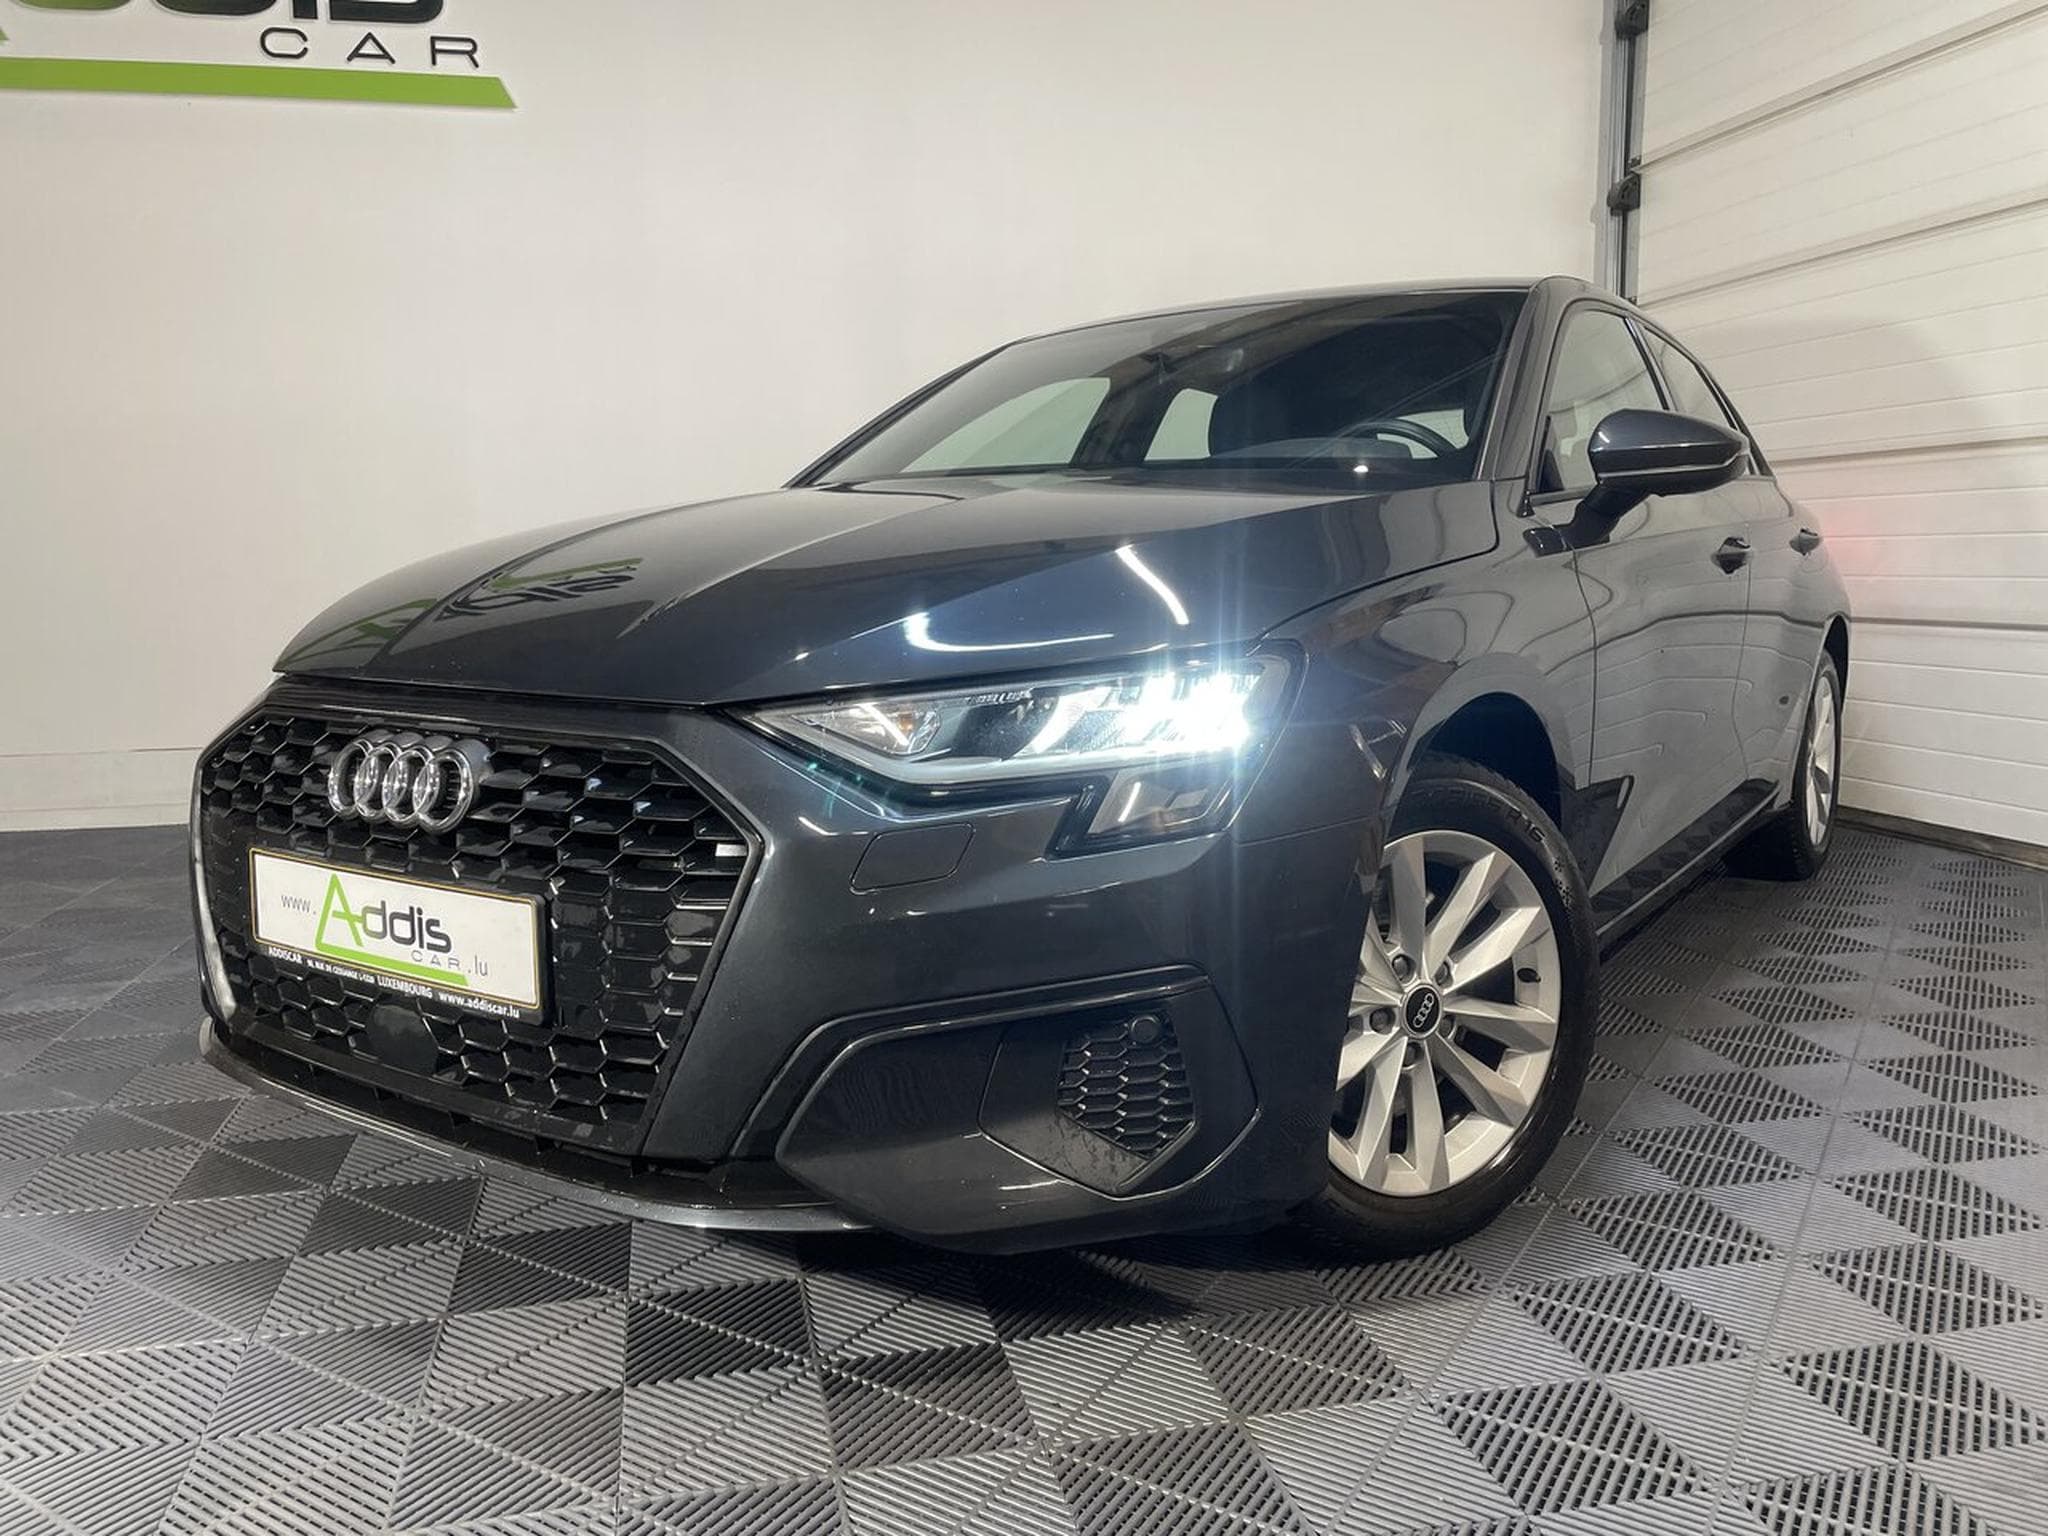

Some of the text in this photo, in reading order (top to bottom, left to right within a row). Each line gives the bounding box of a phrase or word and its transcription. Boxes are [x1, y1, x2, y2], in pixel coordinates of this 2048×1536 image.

[260, 26, 480, 68] CAR
[314, 872, 453, 953] Addis
[411, 950, 461, 970] CAR
[377, 974, 433, 999] LUXEMBOURG
[438, 990, 520, 1019] www.addiscar.lu
